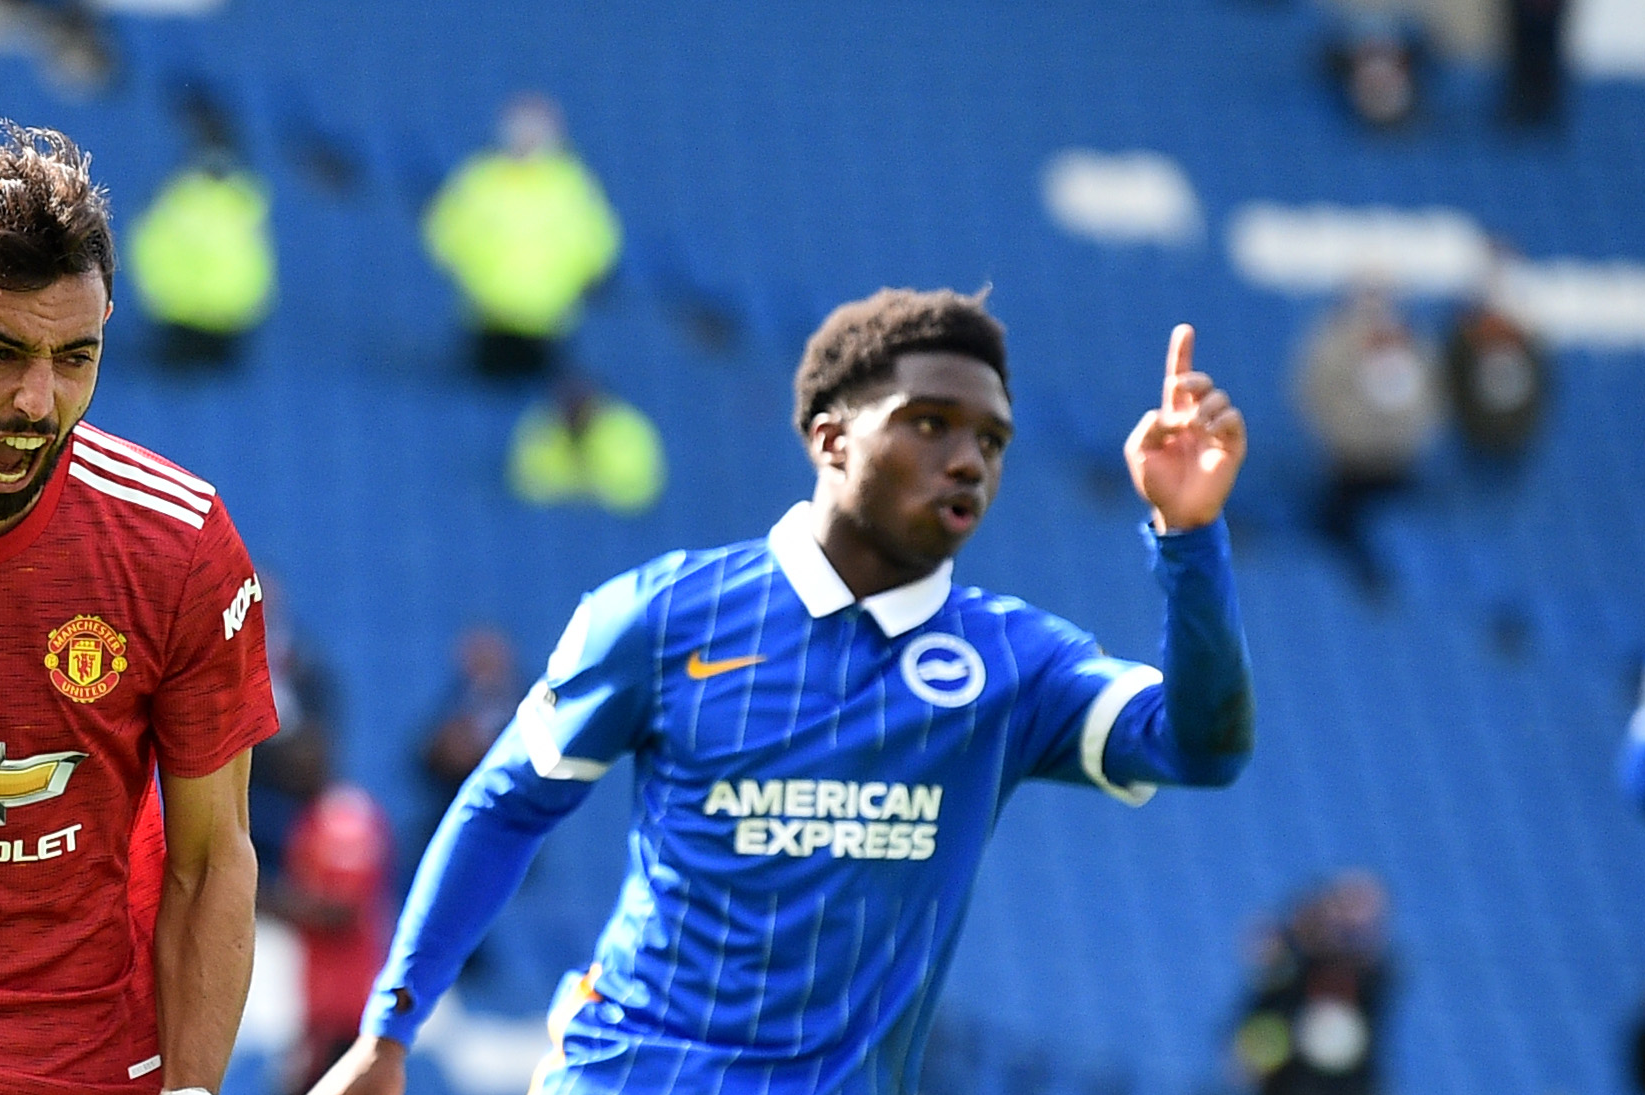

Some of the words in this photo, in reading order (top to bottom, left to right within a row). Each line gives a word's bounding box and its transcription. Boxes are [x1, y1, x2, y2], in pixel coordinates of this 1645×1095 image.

[53, 621, 120, 652] MANCHESTER
[61, 681, 107, 698] UNITED
[704, 779, 943, 821] AMERICAN
[734, 818, 938, 860] EXPRESS
